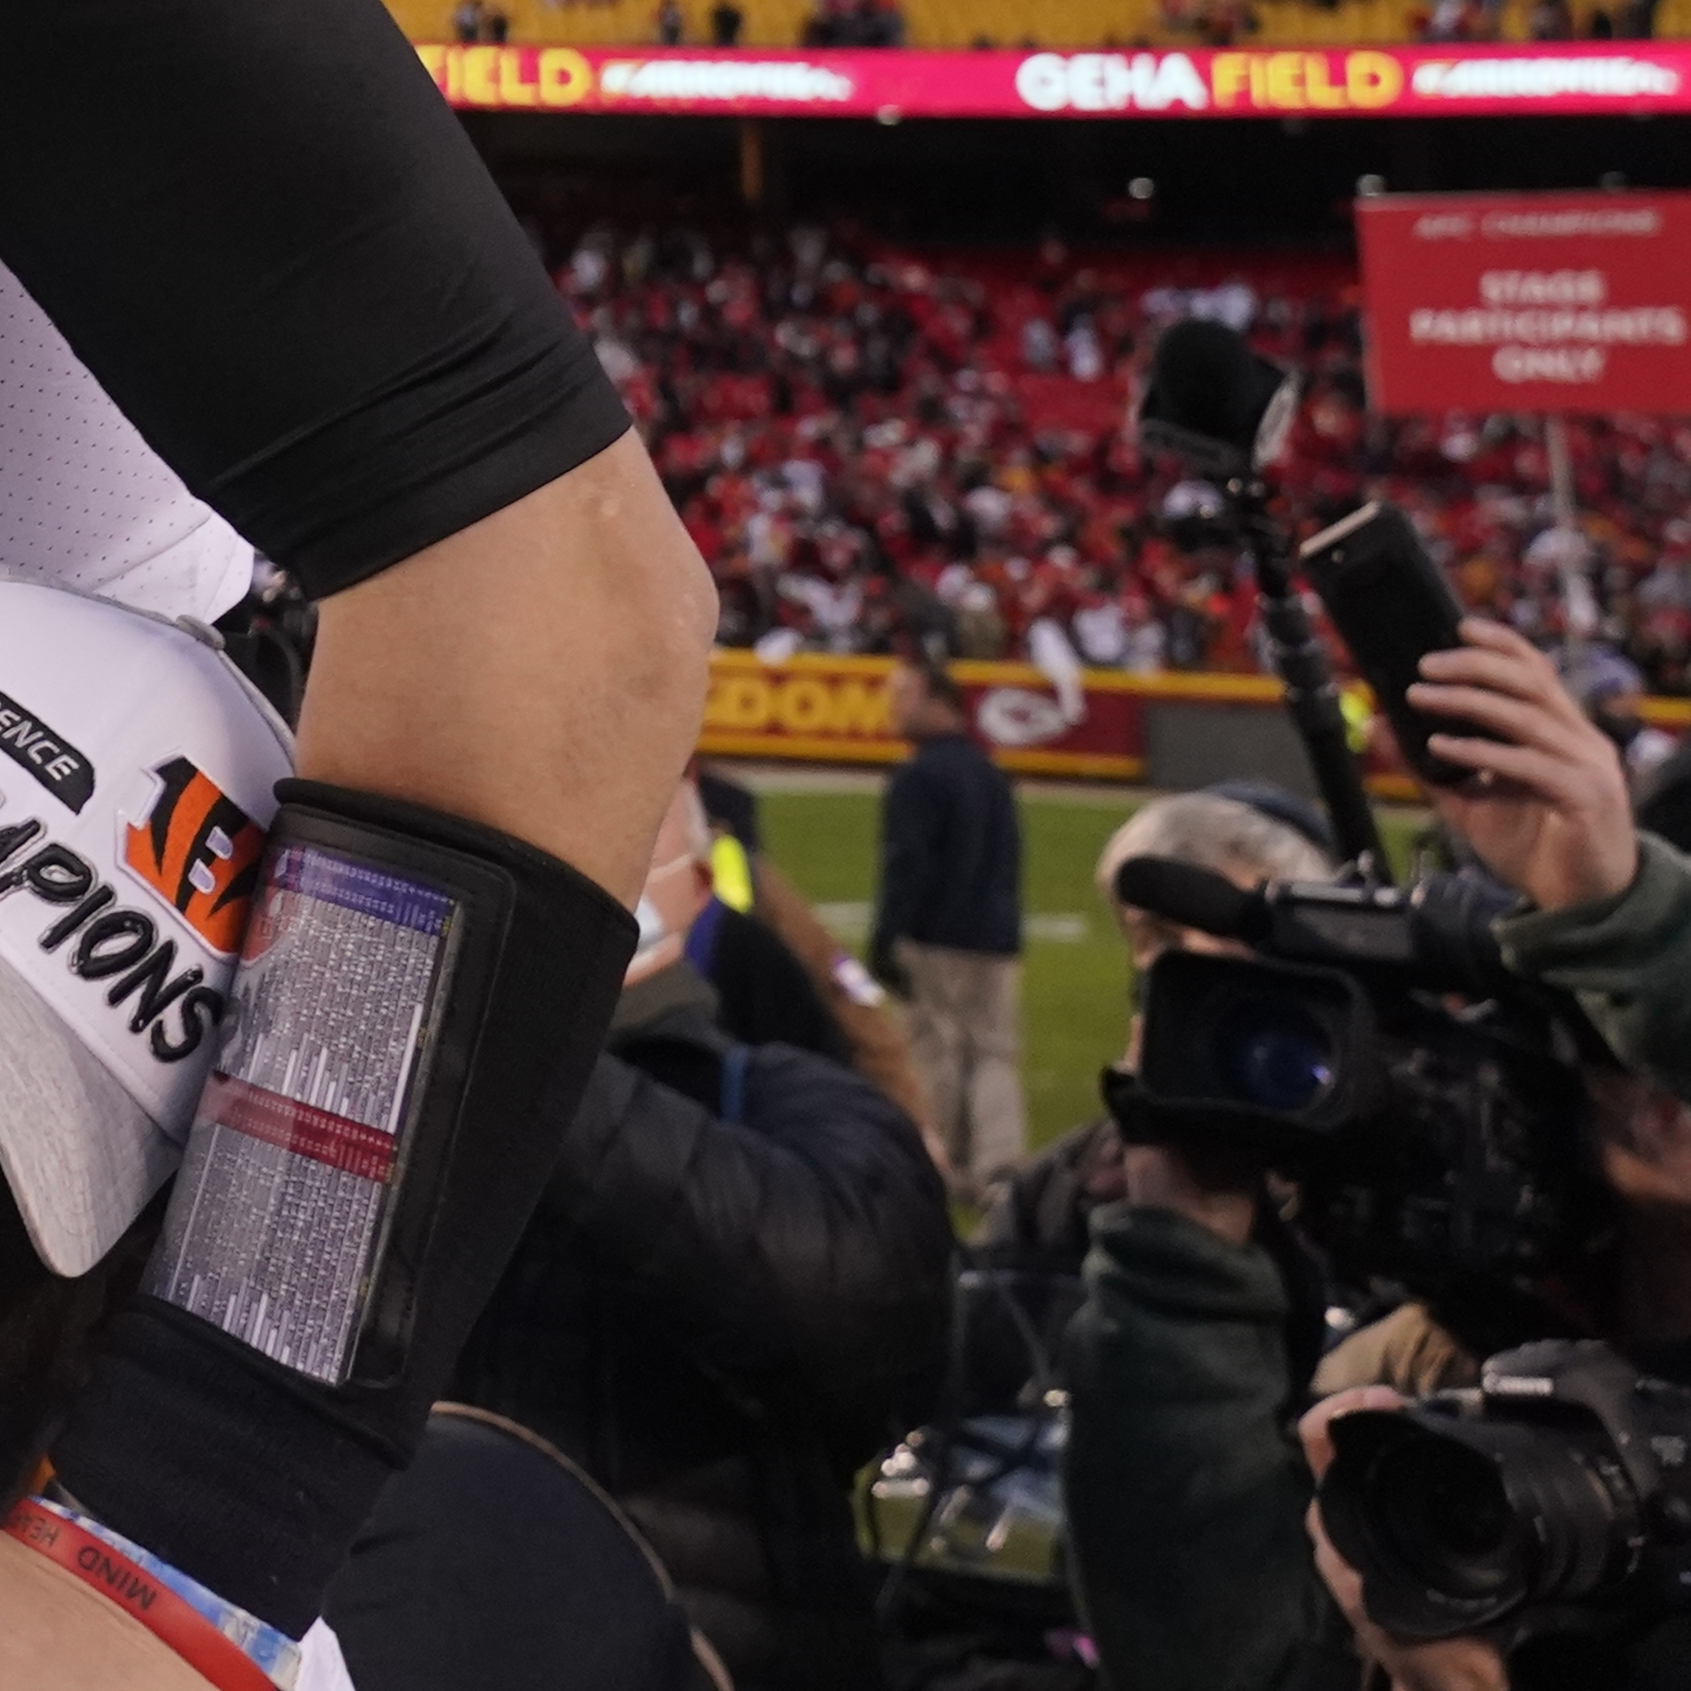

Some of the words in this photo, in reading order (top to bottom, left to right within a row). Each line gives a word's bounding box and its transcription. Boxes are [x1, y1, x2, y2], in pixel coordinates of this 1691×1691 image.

[1016, 52, 1208, 110] GEHA
[1211, 50, 1404, 109] FIELD
[1479, 270, 1605, 304] STAGE
[1410, 307, 1686, 345] PARTICIPANTS
[1491, 345, 1606, 384] ONLY
[77, 1546, 158, 1609] MIND
